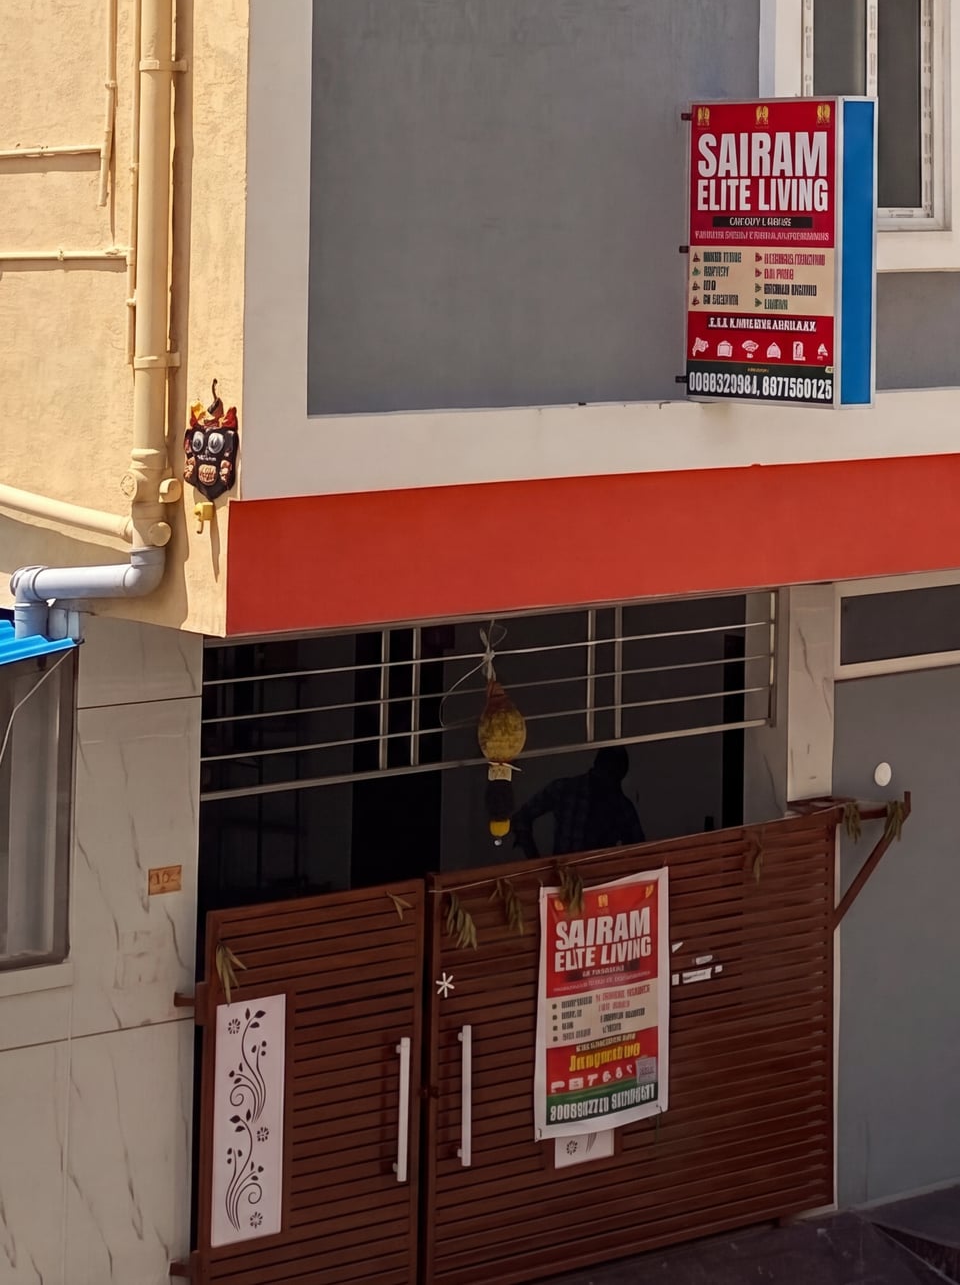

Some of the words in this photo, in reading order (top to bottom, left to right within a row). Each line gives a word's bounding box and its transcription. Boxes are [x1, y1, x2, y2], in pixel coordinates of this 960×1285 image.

[697, 131, 828, 177] SAIRAM
[697, 178, 751, 211] ELITE
[758, 178, 829, 212] LIVING
[555, 906, 650, 951] SAIRAM
[554, 946, 597, 973] ELITE
[600, 935, 652, 965] LIVING
